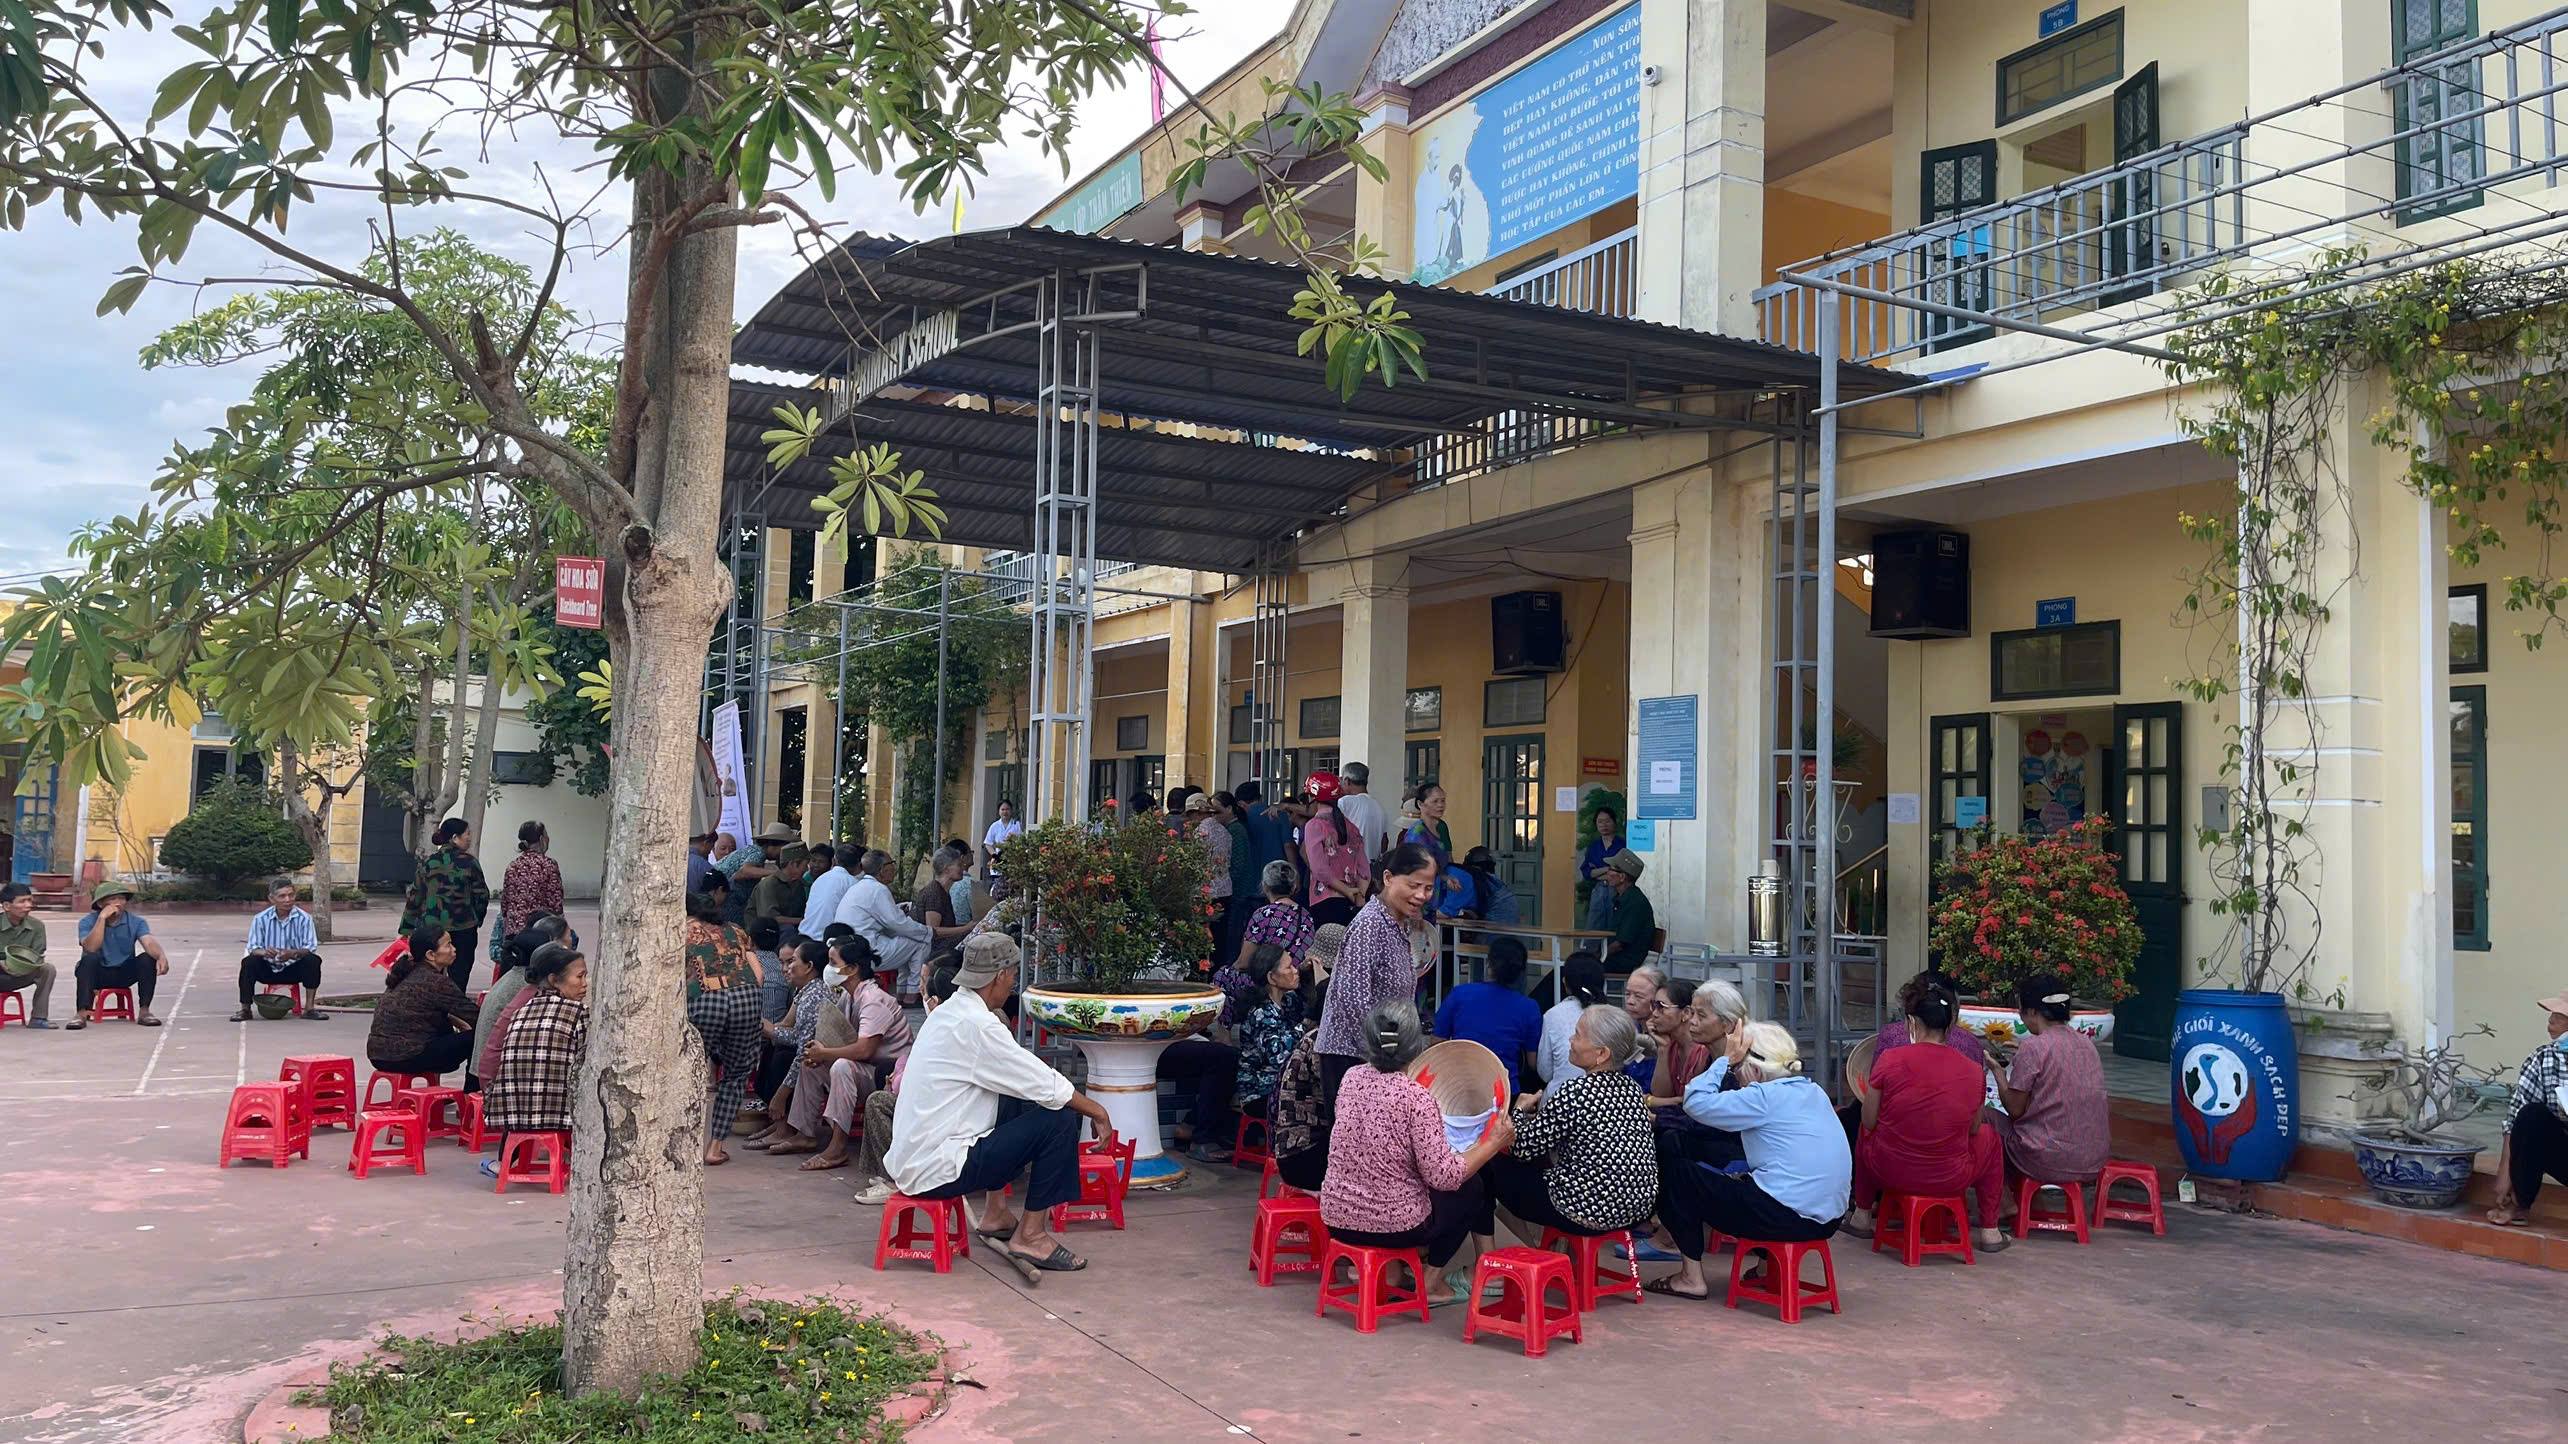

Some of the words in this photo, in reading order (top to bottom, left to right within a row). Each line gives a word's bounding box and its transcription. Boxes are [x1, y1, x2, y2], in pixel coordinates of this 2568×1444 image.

[1527, 86, 1550, 105] NAM
[1592, 48, 1614, 69] NÊN
[1618, 32, 1640, 54] TƯƠ
[1502, 152, 1524, 172] VINH
[1526, 136, 1558, 160] QUANG
[1606, 102, 1622, 118] VAI
[1626, 91, 1640, 107] VỚ
[1526, 105, 1547, 124] HAY
[1528, 120, 1551, 140] NAM
[1529, 176, 1548, 193] HAY
[1630, 132, 1640, 144] L
[852, 330, 907, 404] PRIMARY
[907, 305, 958, 370] SCHOOL
[572, 568, 584, 589] HOA
[2184, 1012, 2214, 1034] GIỚI
[2218, 1020, 2264, 1055] XANH
[2260, 1054, 2286, 1100] SẠCH
[2274, 1103, 2288, 1137] ĐẸP
